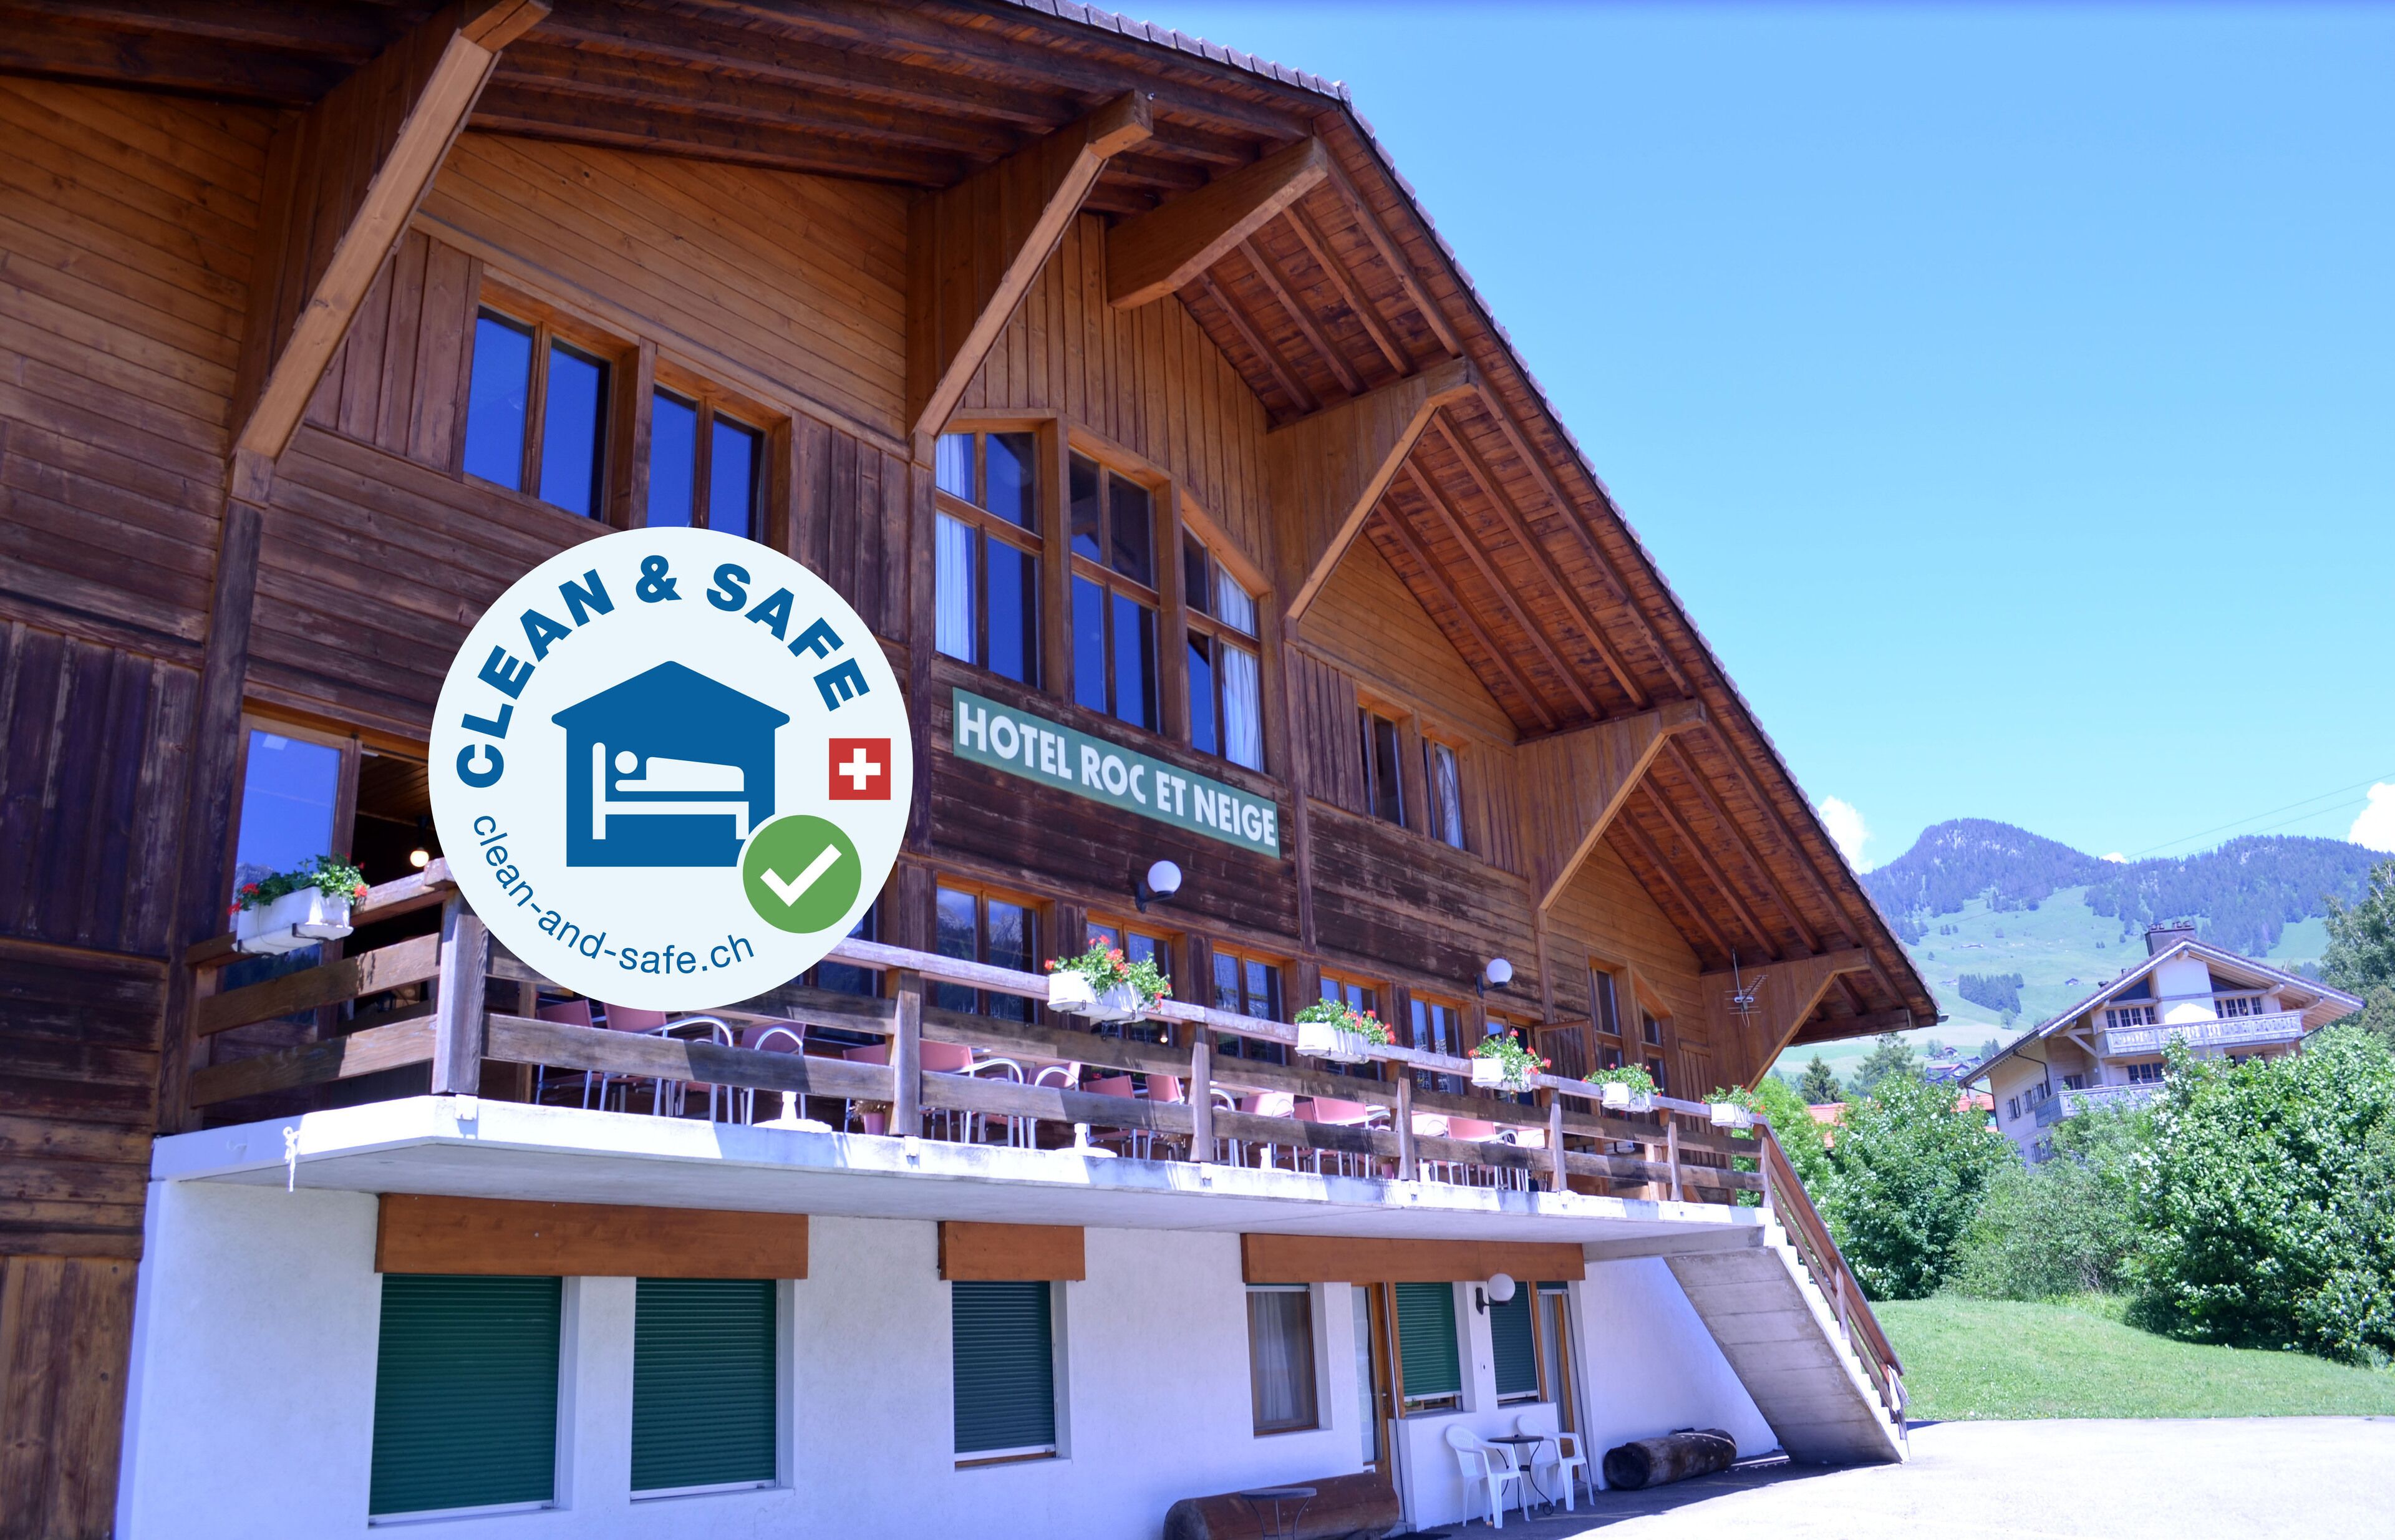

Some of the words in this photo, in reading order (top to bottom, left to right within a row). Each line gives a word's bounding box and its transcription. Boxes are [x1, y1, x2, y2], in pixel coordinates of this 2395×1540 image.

[959, 701, 1072, 780] HOTEL
[1081, 744, 1146, 805] ROC
[1156, 770, 1186, 816] ET
[1194, 785, 1277, 847] NEIGE
